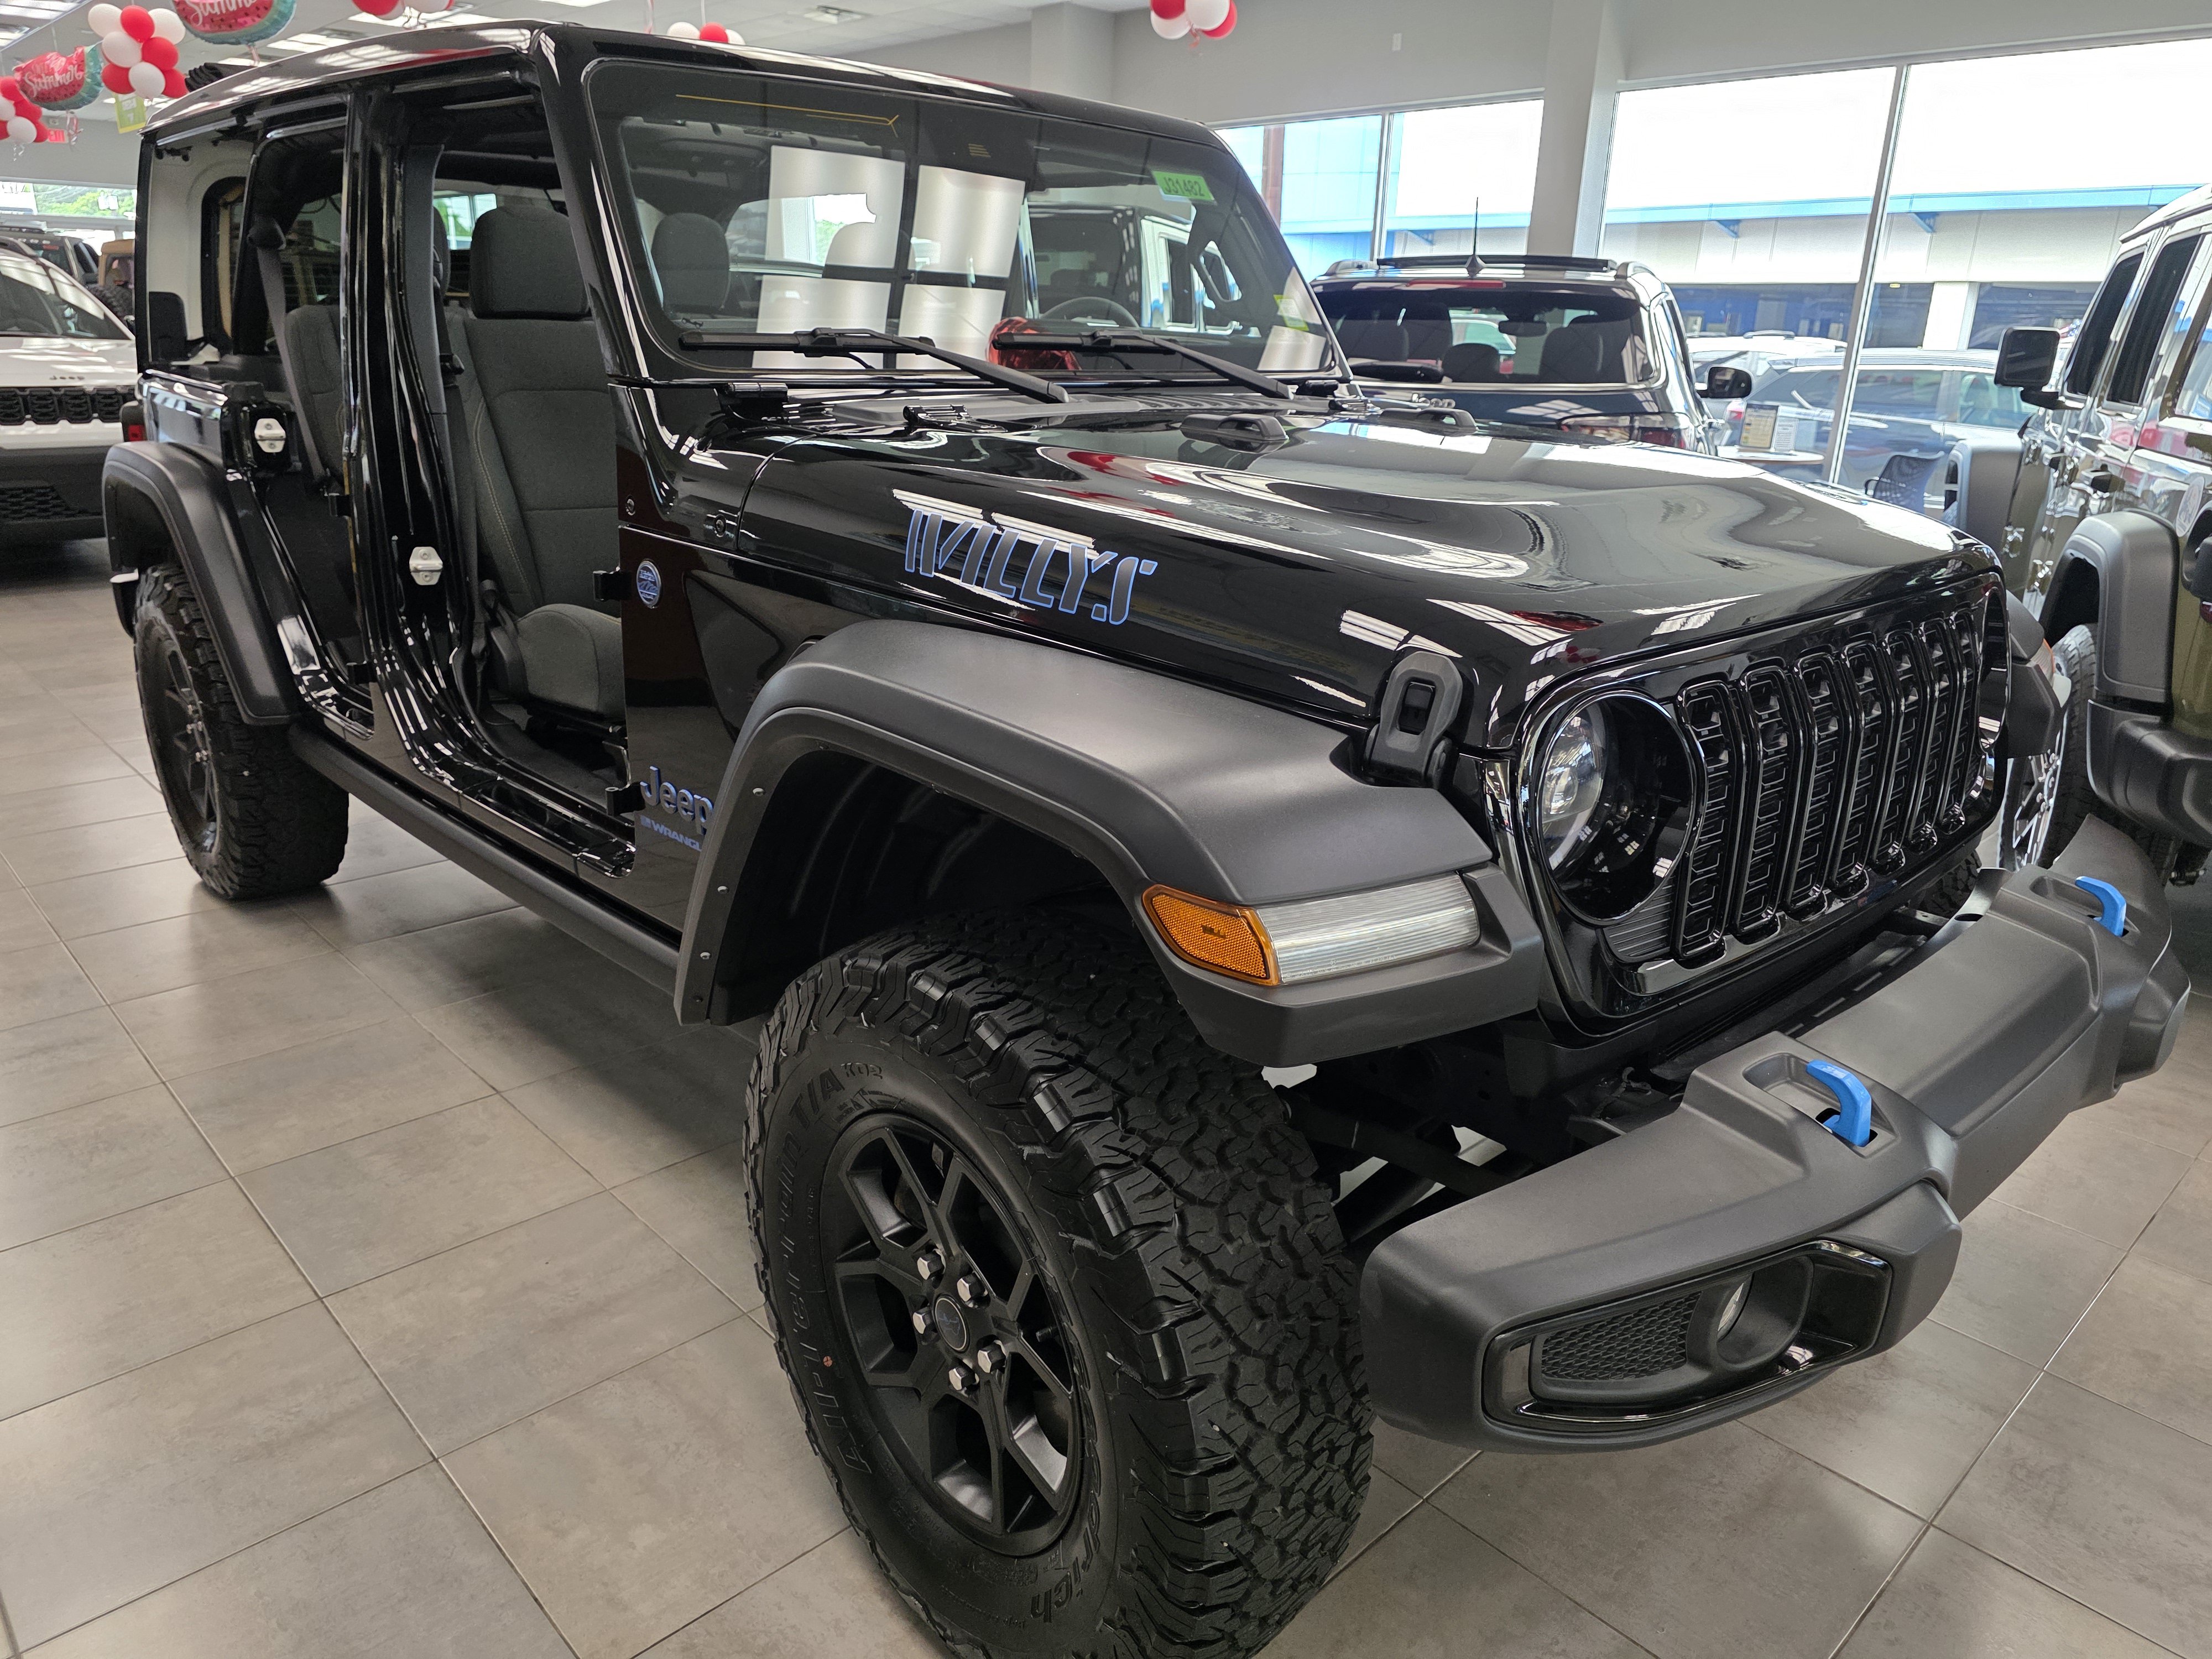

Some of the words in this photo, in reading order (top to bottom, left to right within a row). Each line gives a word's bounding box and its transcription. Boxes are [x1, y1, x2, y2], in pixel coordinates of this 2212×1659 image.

[1164, 176, 1205, 197] J31482
[904, 508, 1159, 625] WILLYS
[639, 765, 714, 836] Jeep
[650, 819, 702, 853] WRANGL
